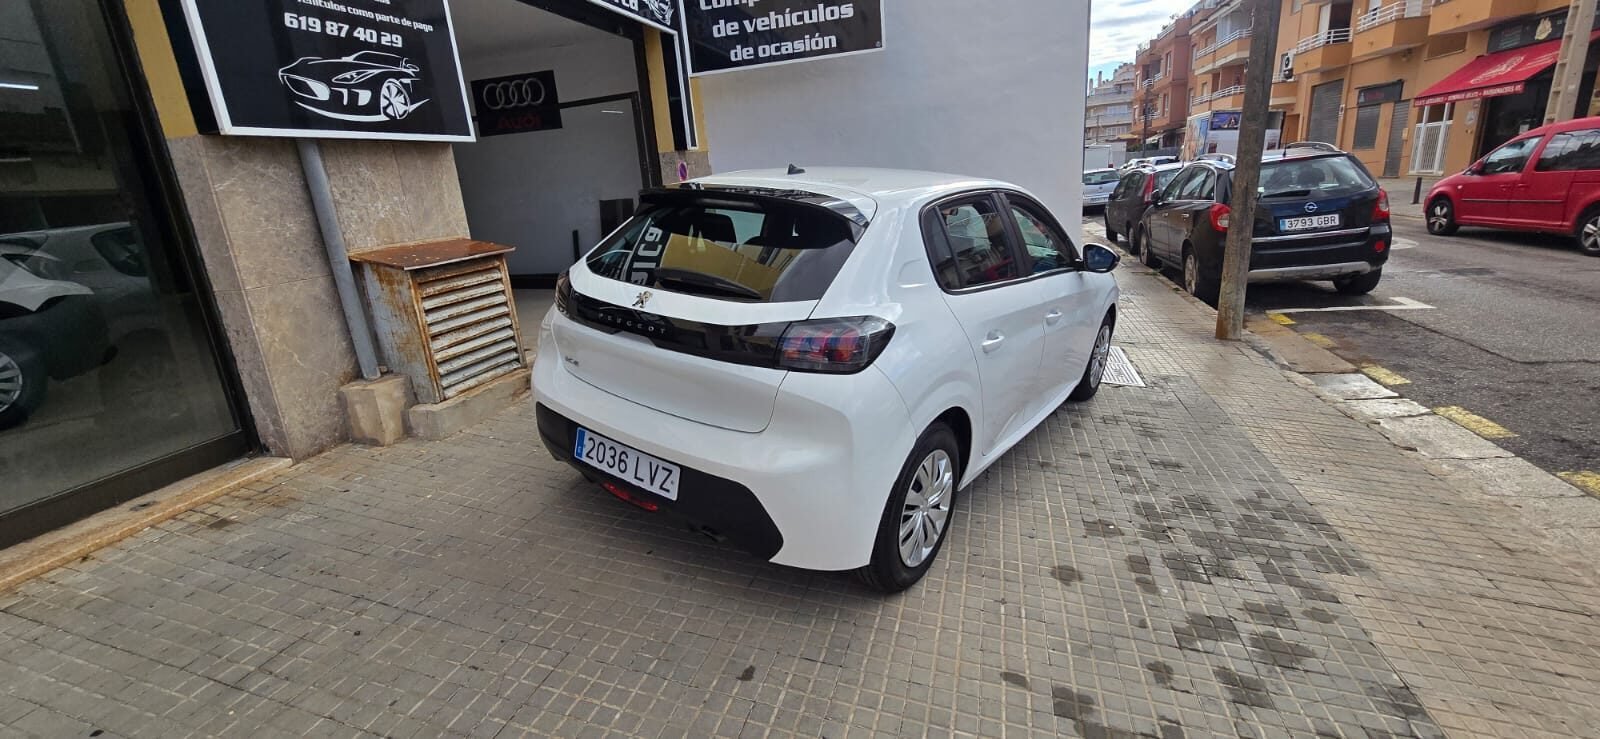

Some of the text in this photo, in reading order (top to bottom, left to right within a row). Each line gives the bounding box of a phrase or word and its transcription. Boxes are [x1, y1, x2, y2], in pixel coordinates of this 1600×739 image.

[284, 12, 402, 48] 619 87 40 29
[297, 0, 434, 33] ehículos como parte de pago
[712, 3, 854, 38] de vehículos
[730, 33, 837, 62] de ocasión
[1287, 215, 1336, 229] 3793 GBR
[585, 437, 673, 493] 2036 LVZ
